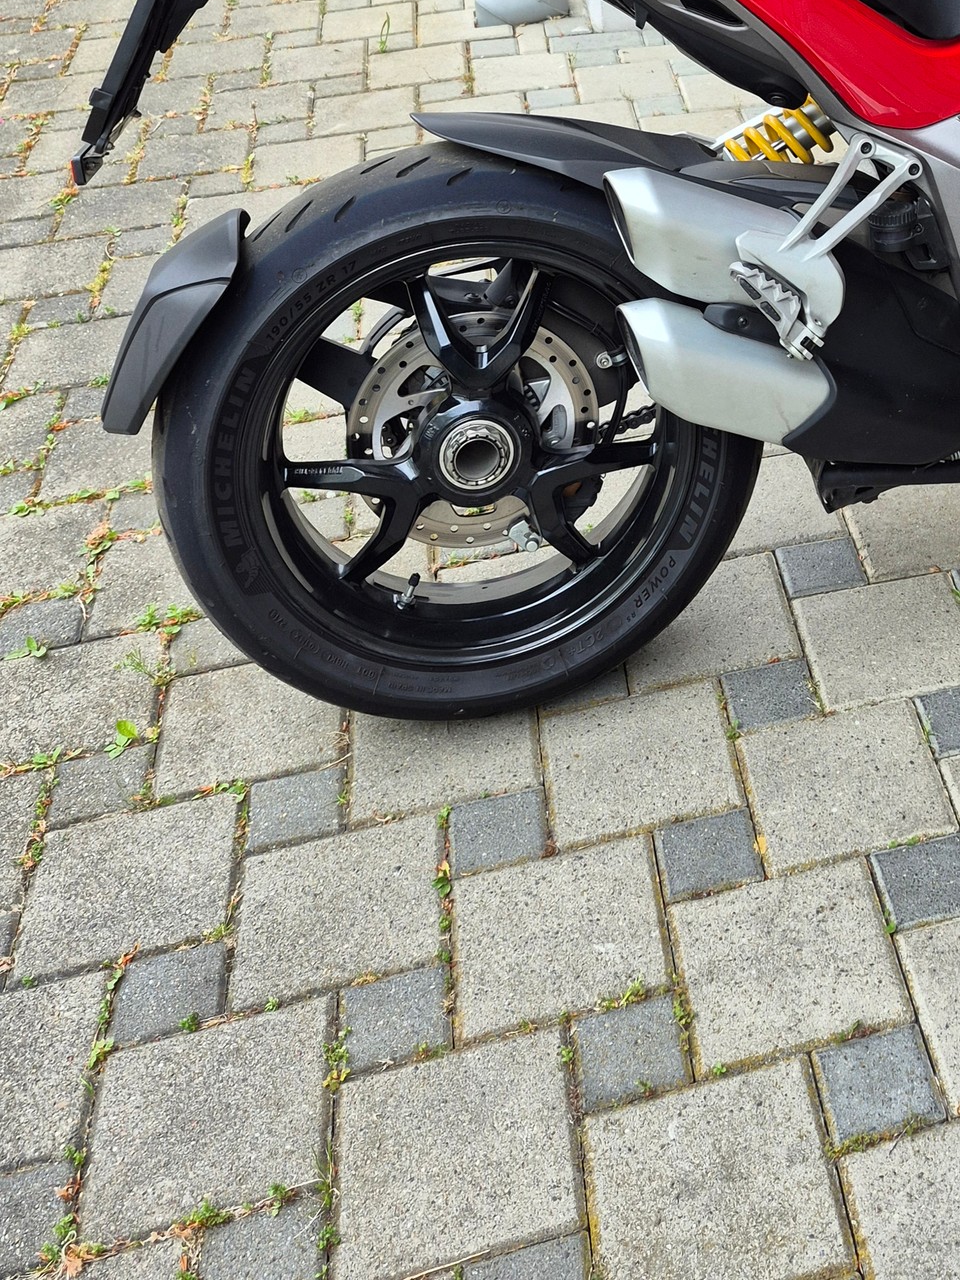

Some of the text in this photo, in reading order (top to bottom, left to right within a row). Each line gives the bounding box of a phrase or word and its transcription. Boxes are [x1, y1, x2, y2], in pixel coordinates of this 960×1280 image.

[266, 260, 358, 342] 190/55 ZR 17
[214, 367, 257, 548] MICHELIN
[635, 555, 677, 609] POWER
